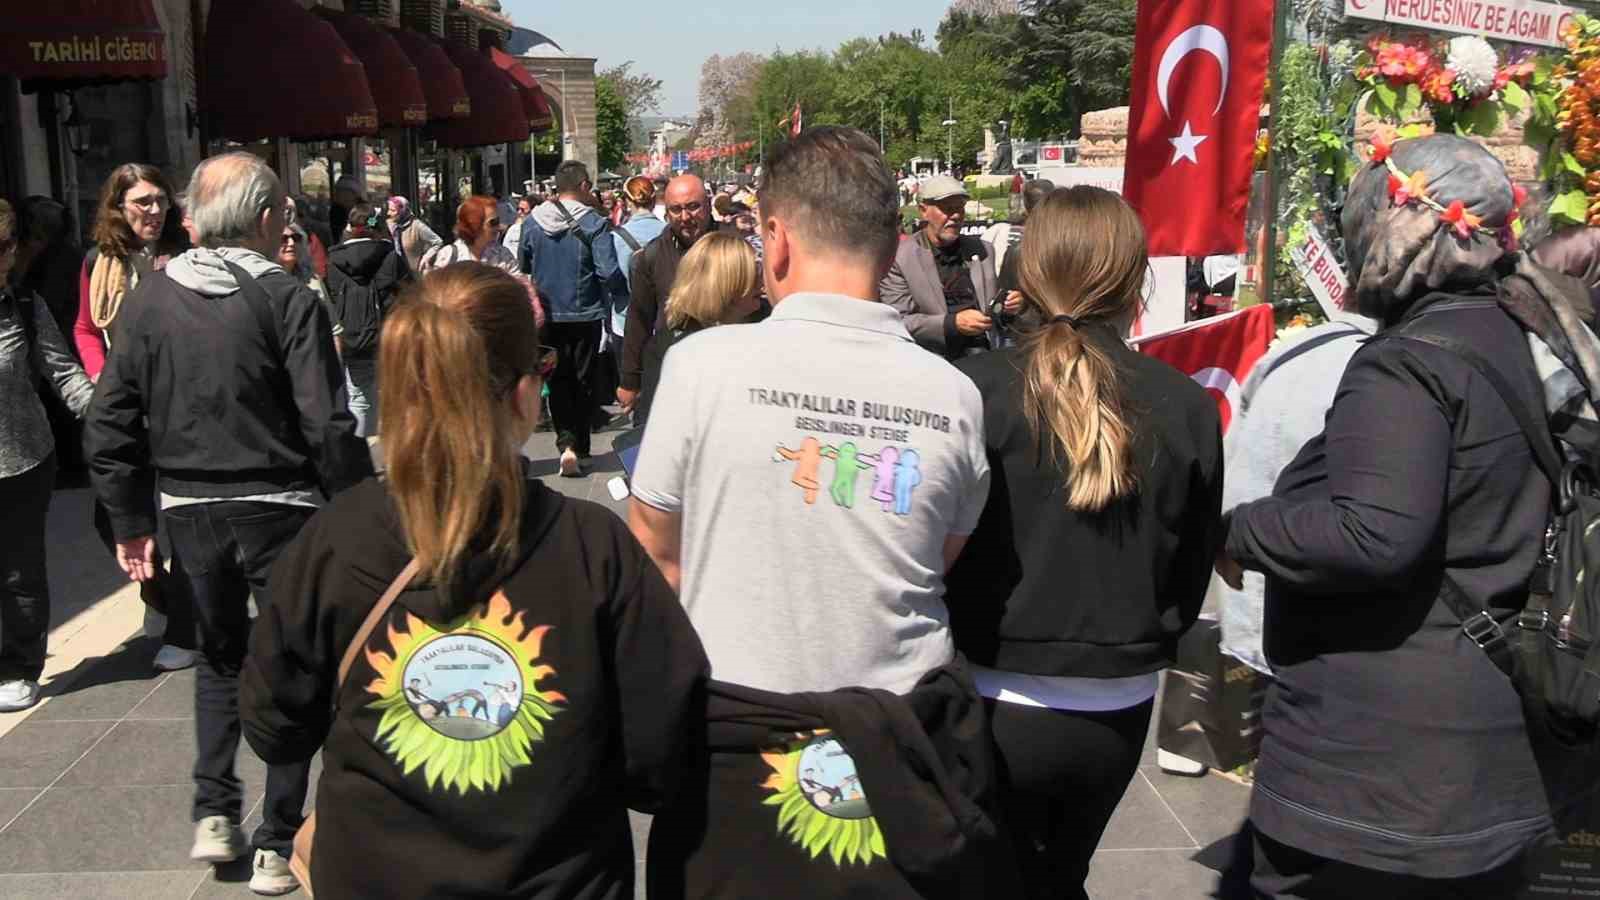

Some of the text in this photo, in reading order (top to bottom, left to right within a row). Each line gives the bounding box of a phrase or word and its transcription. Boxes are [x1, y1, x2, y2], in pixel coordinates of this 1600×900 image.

[1484, 5, 1506, 33] BE
[1507, 9, 1552, 40] AGAM
[29, 35, 101, 62] TARİHİ
[748, 387, 857, 418] TRAKYALILAR
